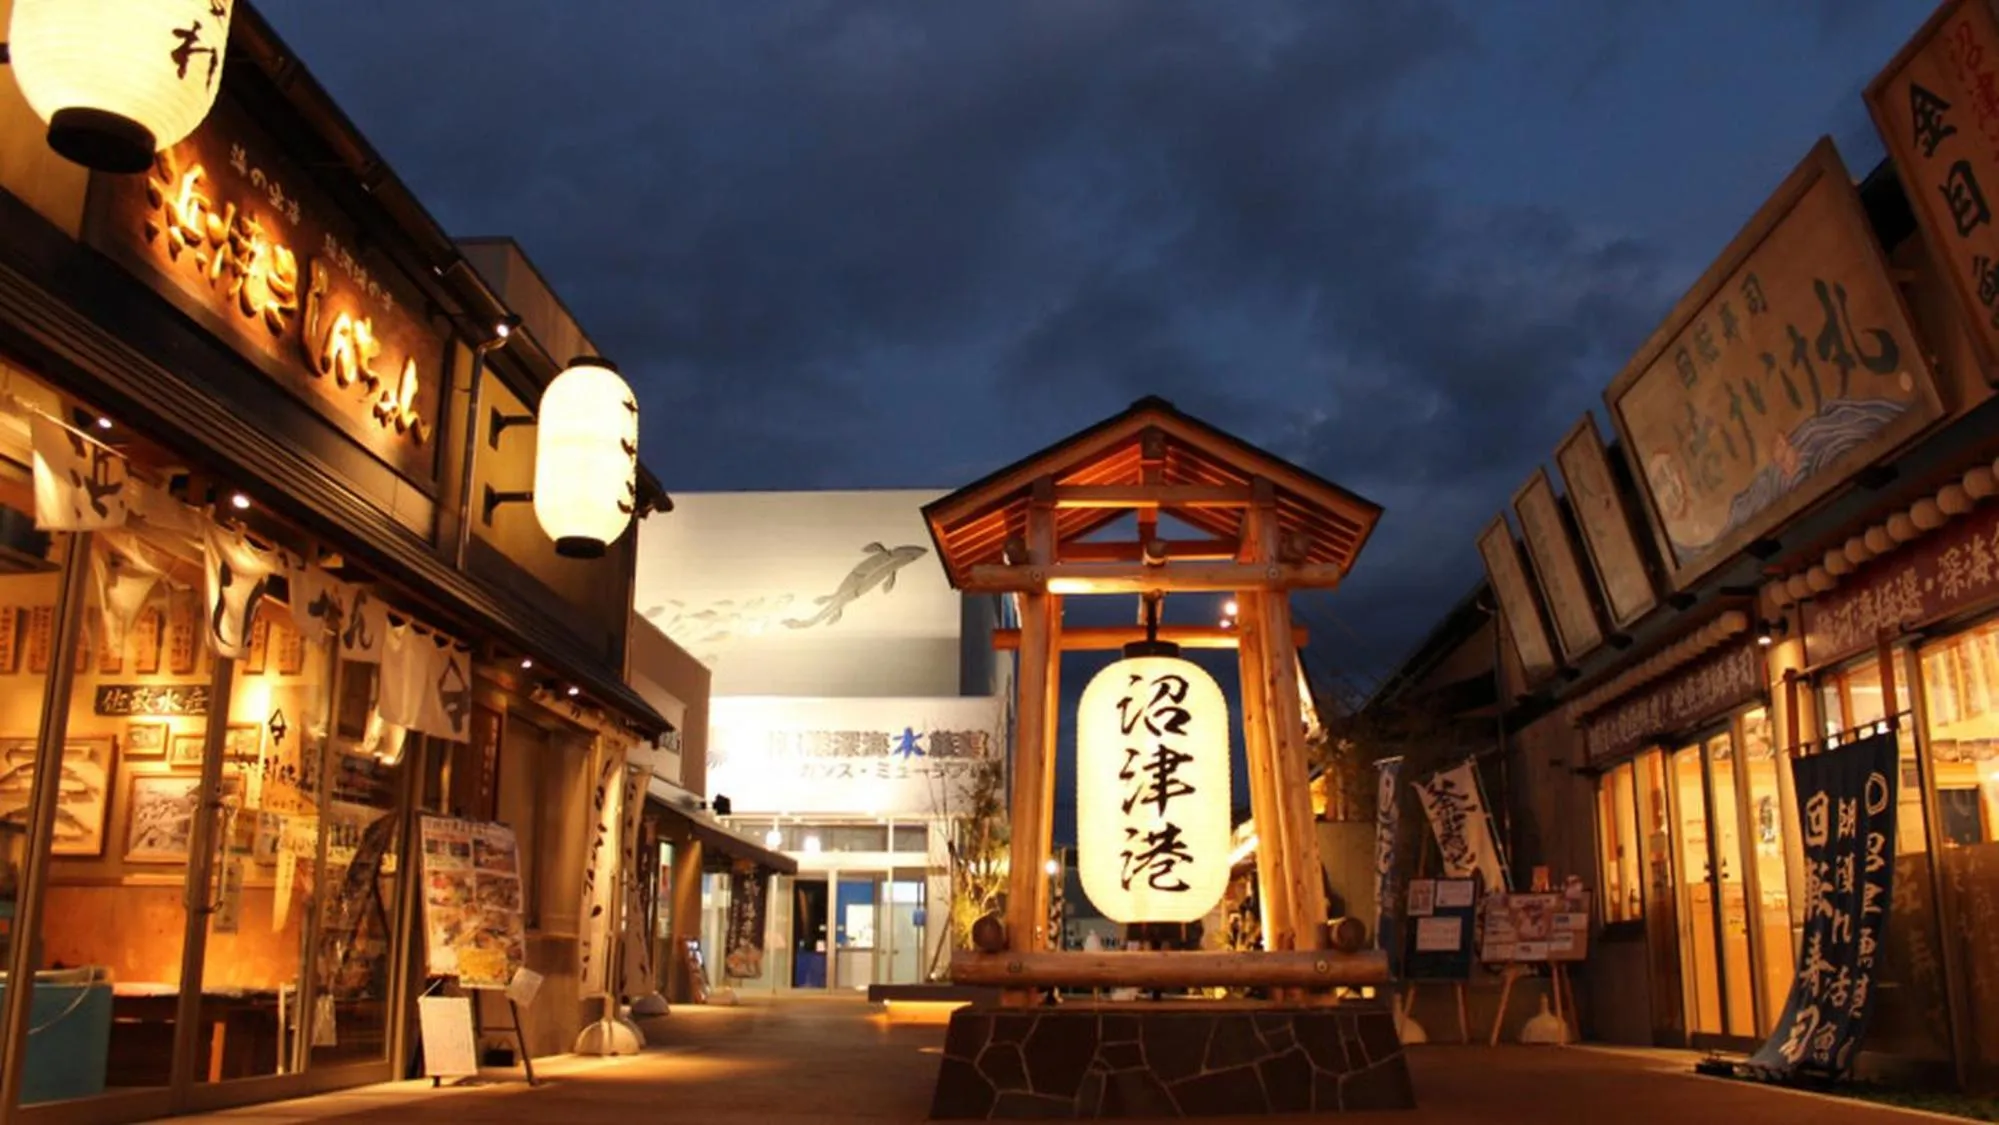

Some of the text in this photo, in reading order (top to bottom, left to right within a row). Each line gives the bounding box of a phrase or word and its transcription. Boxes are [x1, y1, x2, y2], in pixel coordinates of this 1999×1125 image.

[1116, 673, 1196, 894] 沼津港
[1779, 788, 1835, 1063] 回転寿司
